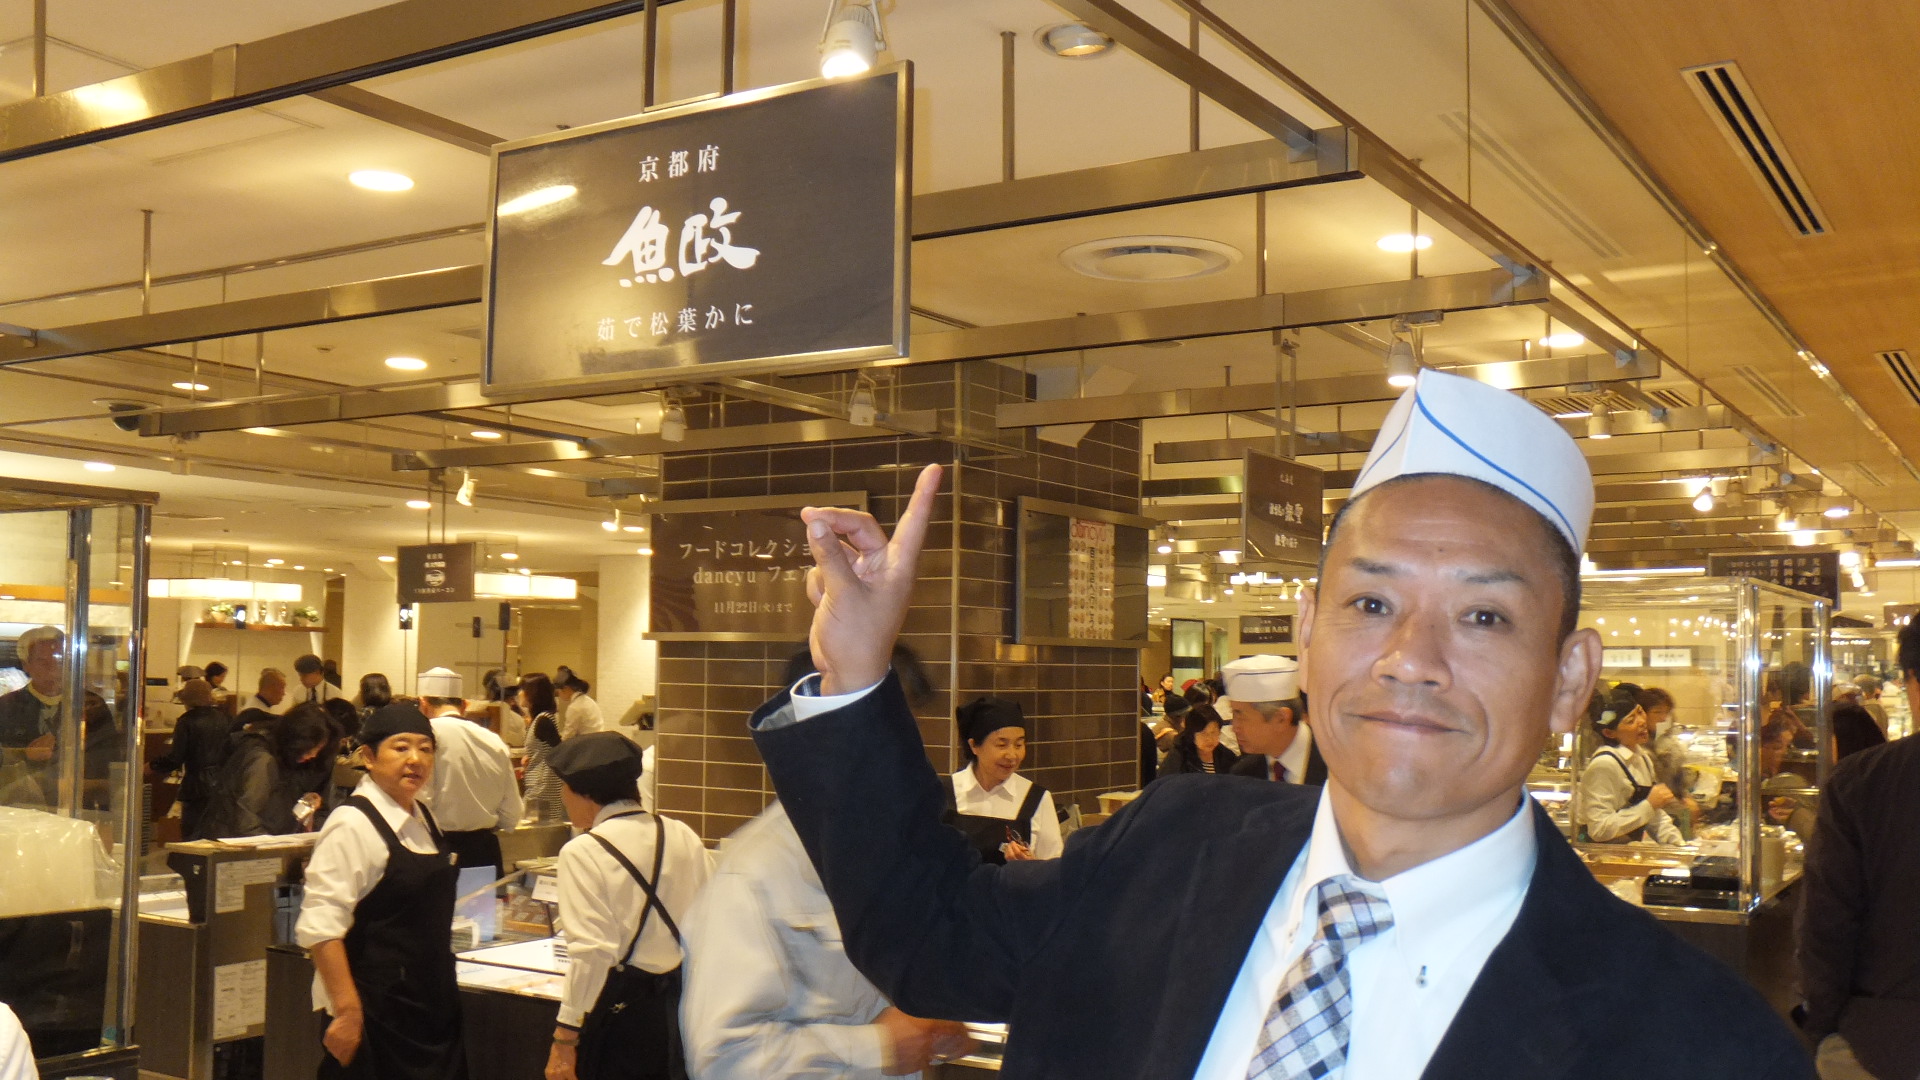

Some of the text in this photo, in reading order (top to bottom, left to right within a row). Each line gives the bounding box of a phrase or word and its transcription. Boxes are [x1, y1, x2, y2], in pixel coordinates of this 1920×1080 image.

[638, 145, 719, 182] 京都府
[602, 197, 760, 287] 魚政
[597, 304, 753, 341] 茹で松葉かに
[693, 568, 756, 586] dancyu
